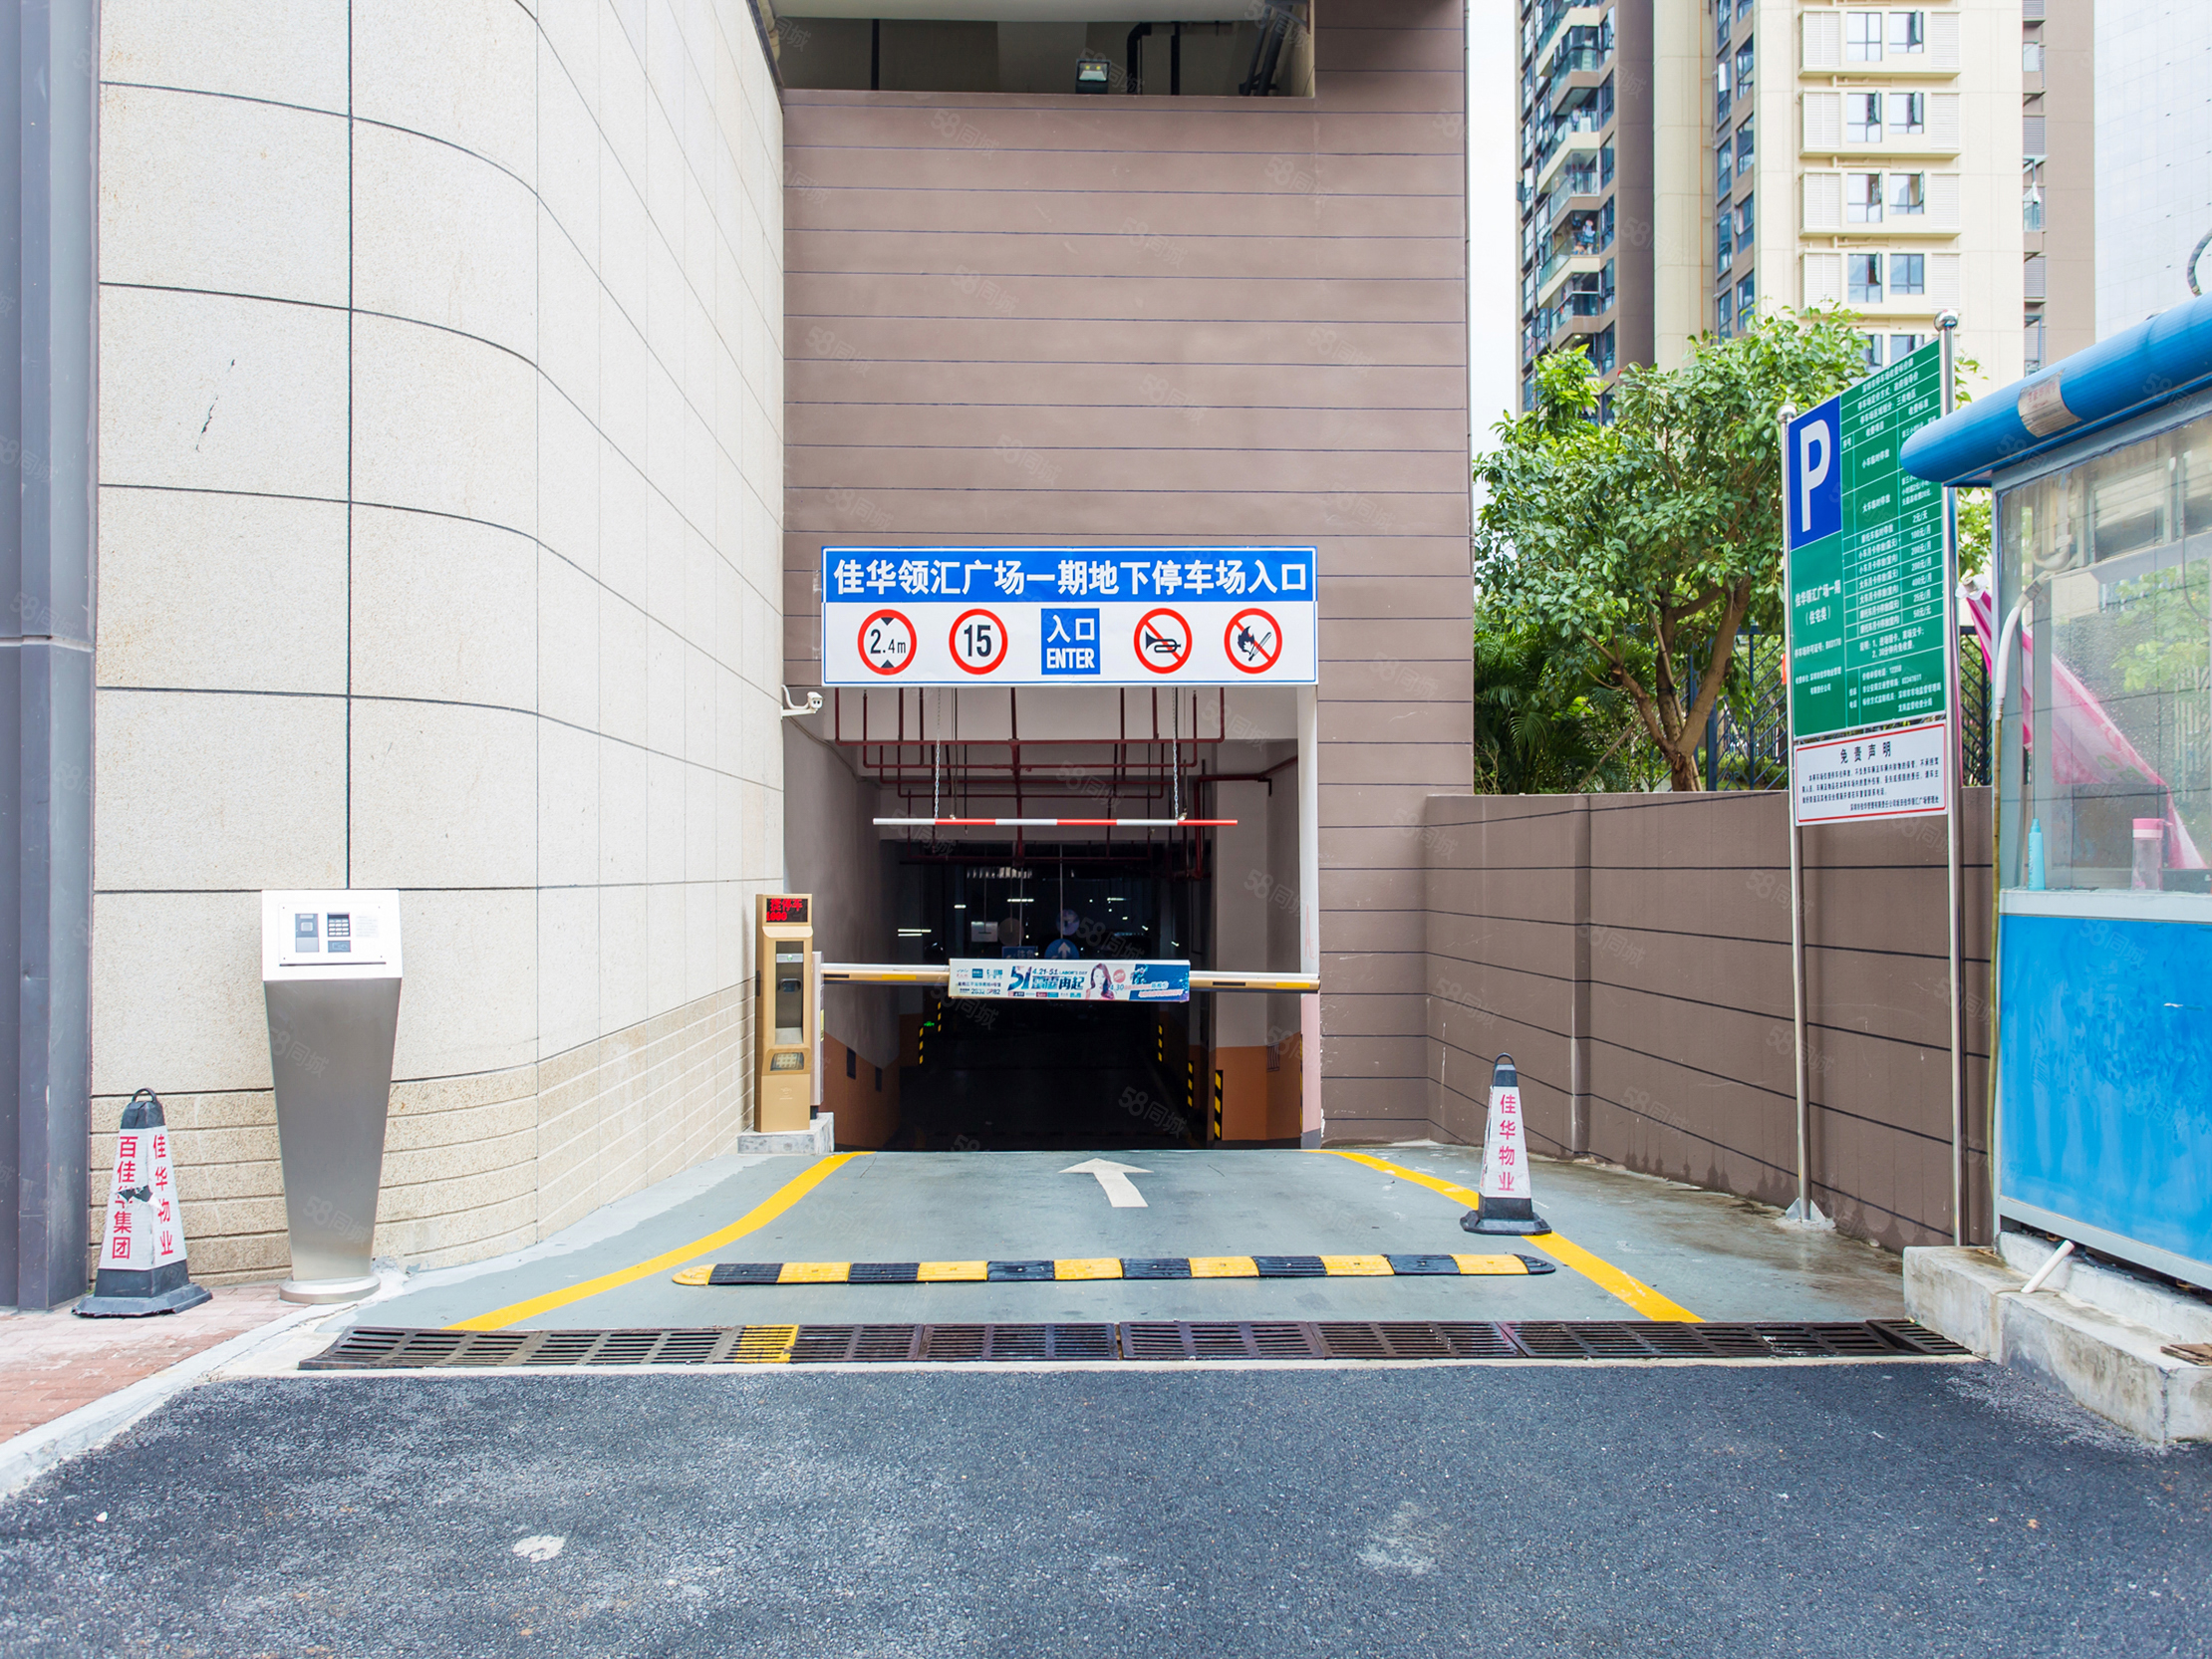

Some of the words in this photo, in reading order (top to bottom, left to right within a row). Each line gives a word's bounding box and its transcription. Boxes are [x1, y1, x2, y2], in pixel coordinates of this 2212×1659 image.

[1801, 419, 1830, 532] P
[834, 560, 1306, 596] 佳华领汇广场一期地下停车场入口
[870, 629, 907, 655] 2.4m
[964, 624, 991, 657] 15
[1046, 615, 1095, 642] 入口
[1047, 648, 1094, 670] ENTER
[1839, 740, 1891, 764] 免责声明
[1498, 1094, 1517, 1192] 佳华物业
[152, 1133, 173, 1255] 佳华物业
